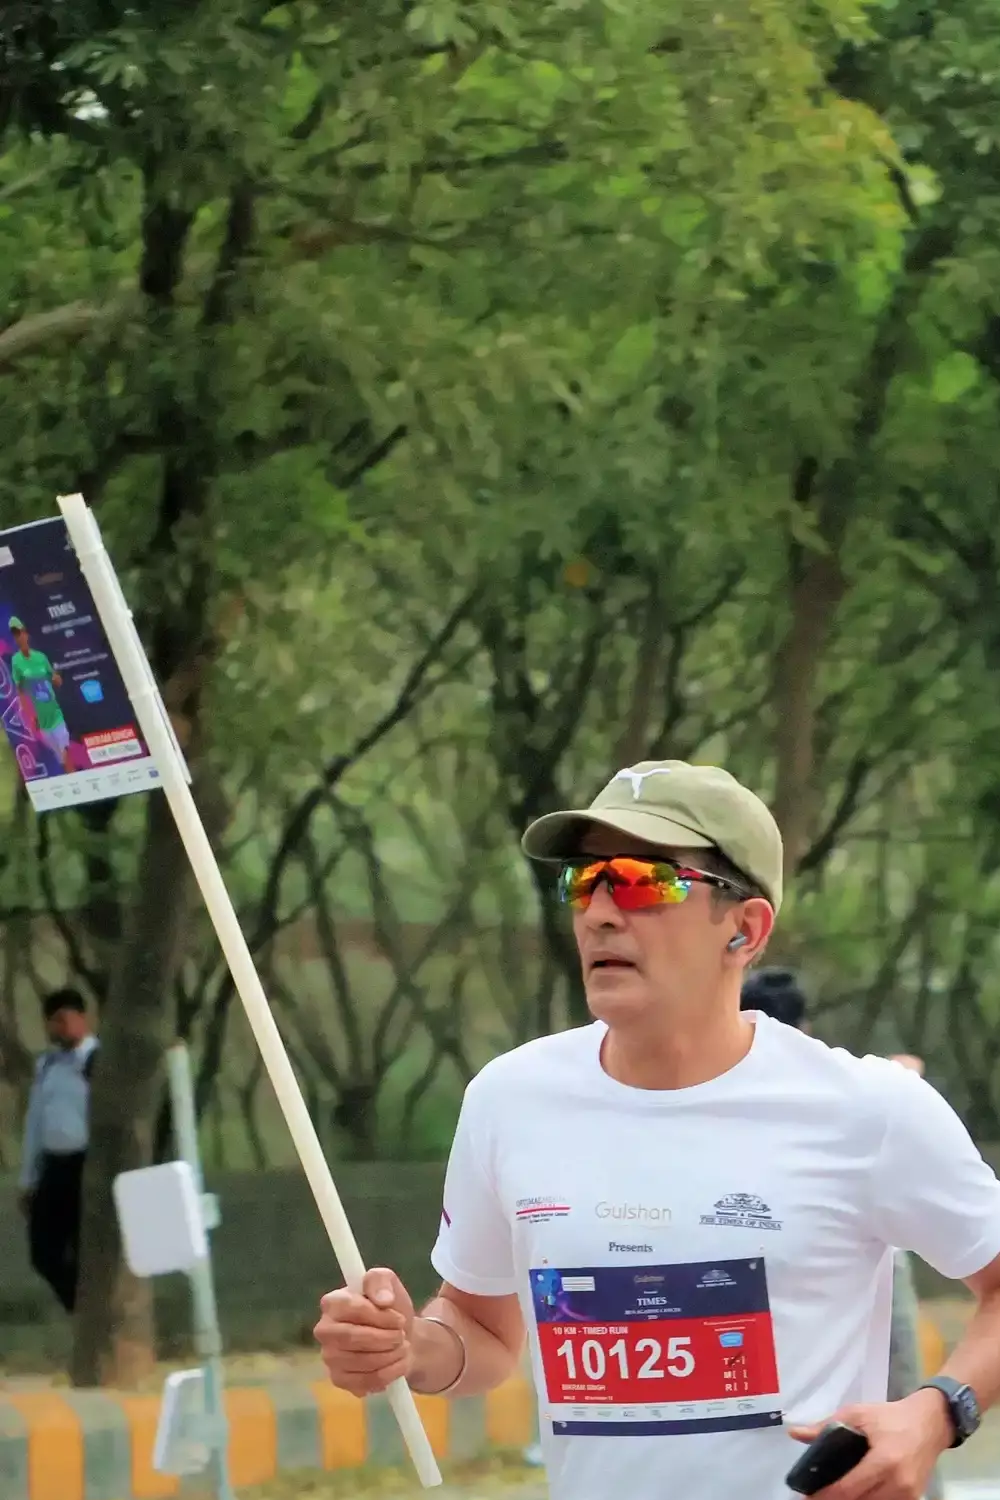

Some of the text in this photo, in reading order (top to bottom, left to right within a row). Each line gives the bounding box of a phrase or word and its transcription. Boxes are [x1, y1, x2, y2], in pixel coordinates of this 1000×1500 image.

[595, 1201, 672, 1221] Gulshan
[609, 1241, 653, 1253] Presents
[636, 1296, 667, 1306] TIMES
[552, 1326, 562, 1335] 10
[564, 1326, 577, 1335] KM
[583, 1326, 608, 1335] TIMED
[609, 1326, 629, 1334] RUN
[557, 1336, 696, 1380] 10125
